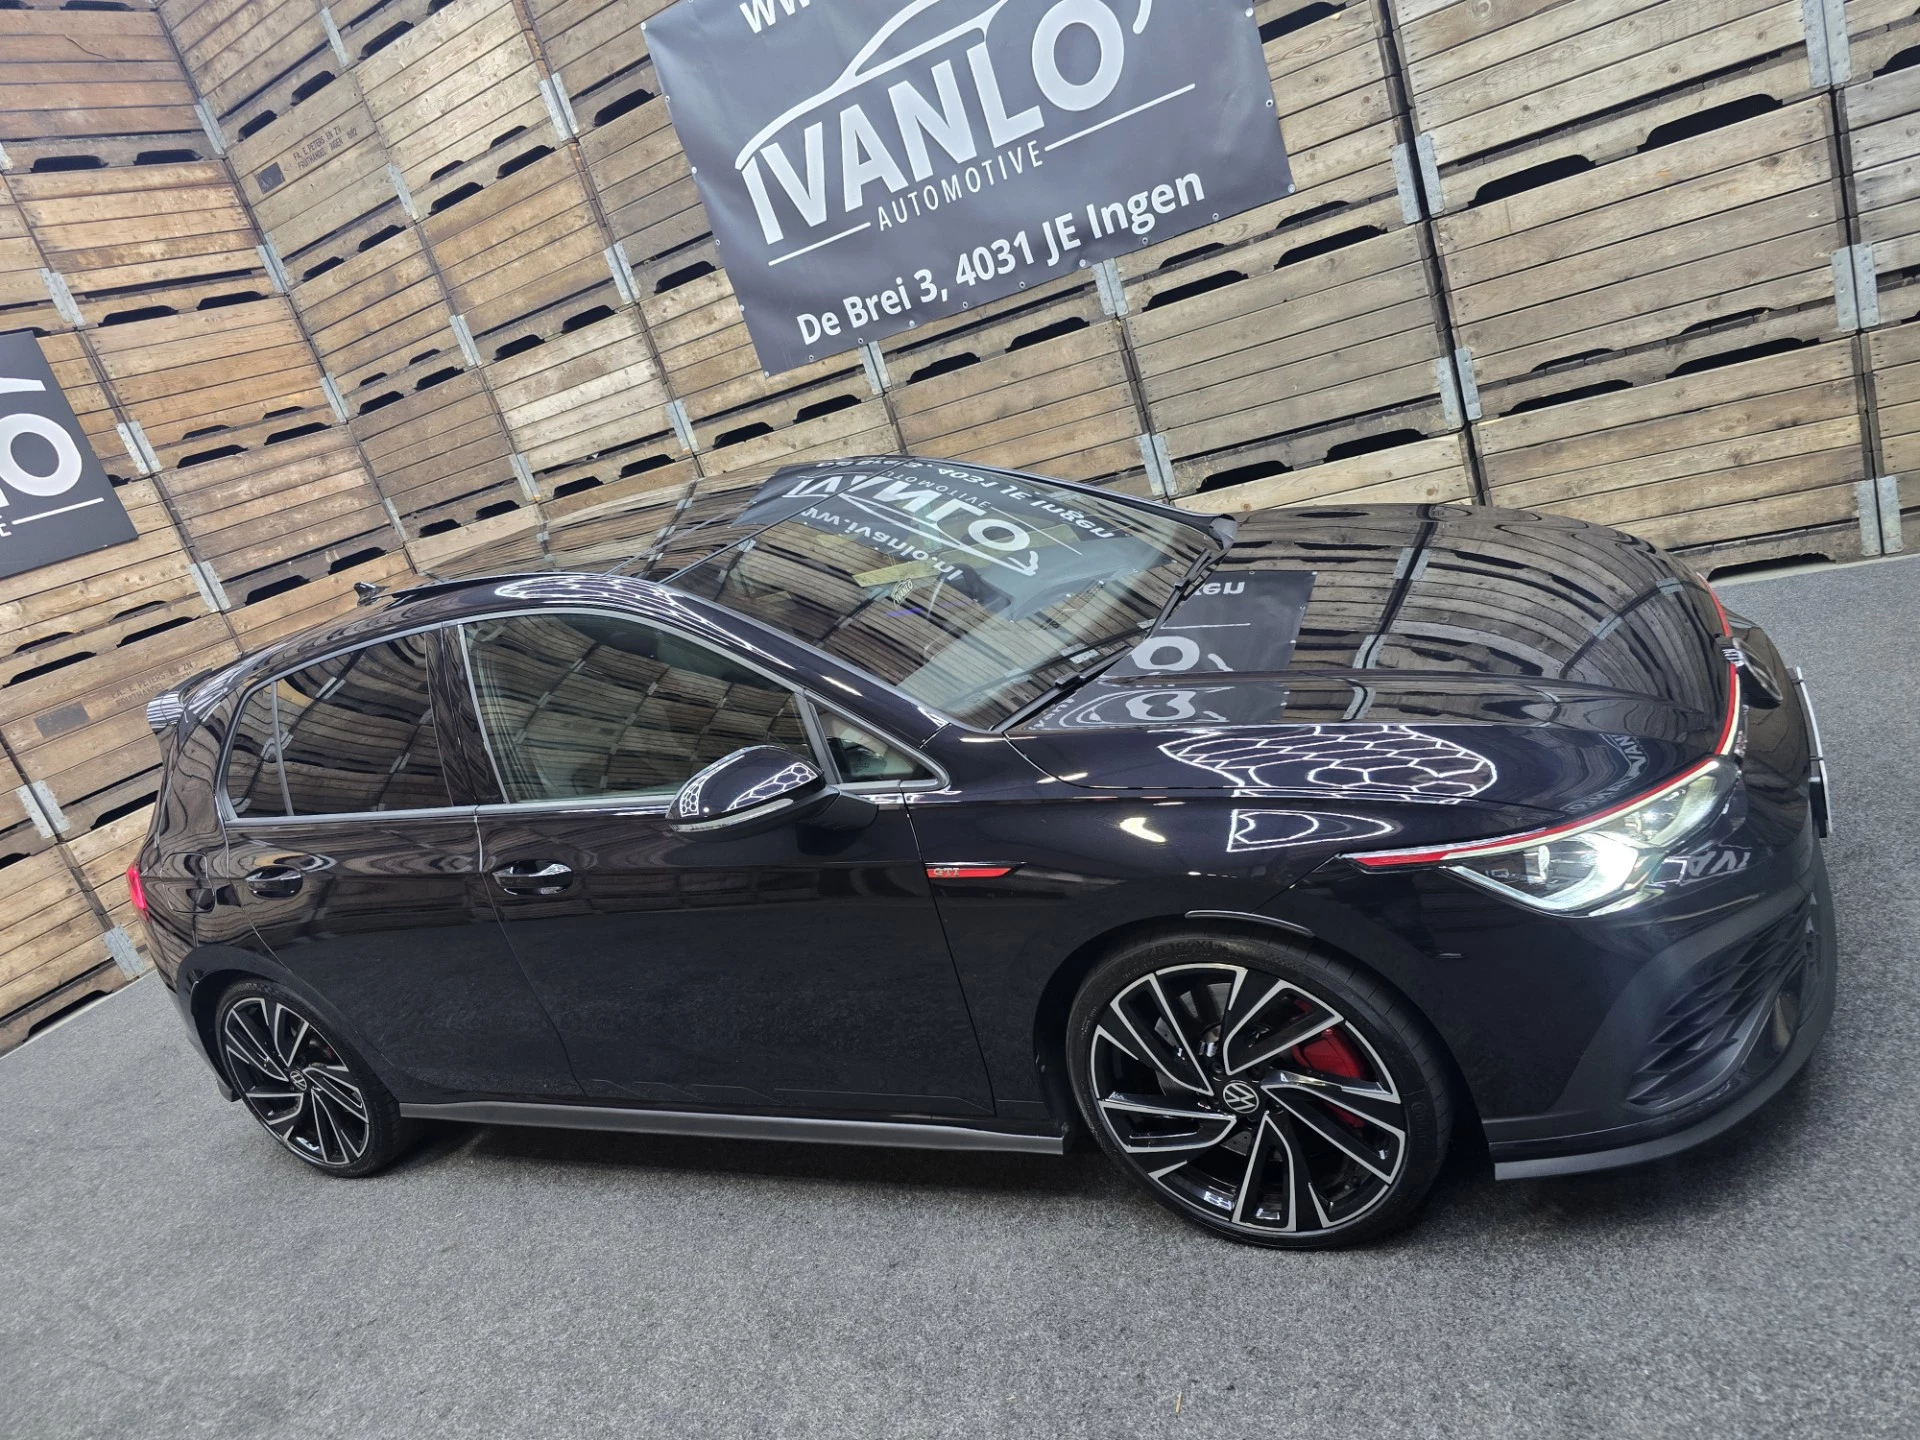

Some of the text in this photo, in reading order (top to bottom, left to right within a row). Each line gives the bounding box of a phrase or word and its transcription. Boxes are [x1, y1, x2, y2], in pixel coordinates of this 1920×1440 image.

[307, 136, 326, 153] PETERS
[742, 0, 1124, 245] IVANLO
[878, 140, 1044, 231] AUTOMOTIVE
[797, 172, 1205, 345] De Brei 3, 4031 JE Ingen
[933, 867, 960, 877] GTI
